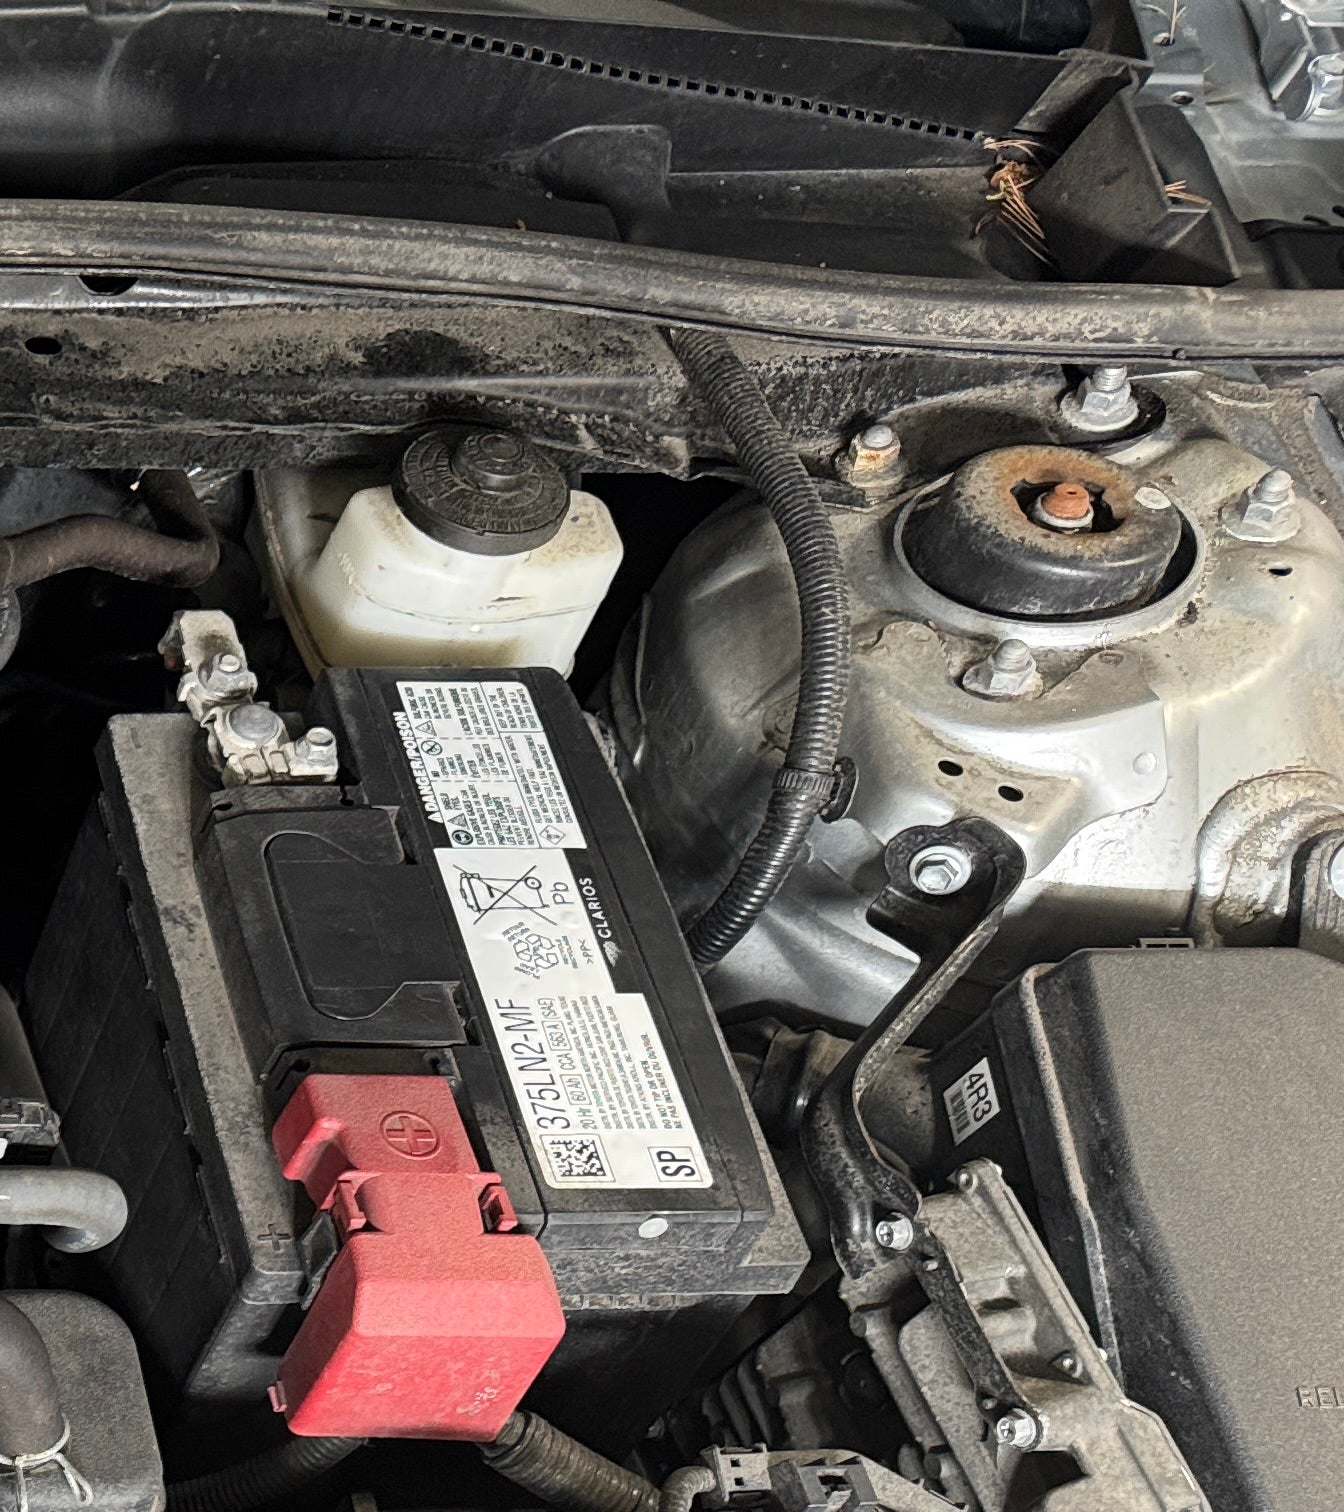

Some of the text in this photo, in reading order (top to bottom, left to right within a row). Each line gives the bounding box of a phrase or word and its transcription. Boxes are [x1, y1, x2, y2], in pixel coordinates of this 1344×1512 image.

[393, 712, 439, 811] DANGER/POISON
[550, 882, 574, 905] Pb
[579, 878, 612, 938] CLARIOS
[549, 1032, 567, 1047] 563
[494, 998, 571, 1129] 375LN2-MF
[556, 1053, 576, 1070] CCA
[566, 1078, 582, 1089] Ah
[966, 1072, 993, 1123] 4R3
[576, 1107, 593, 1117] Hr
[580, 1119, 598, 1130] 20
[656, 1151, 696, 1177] SP
